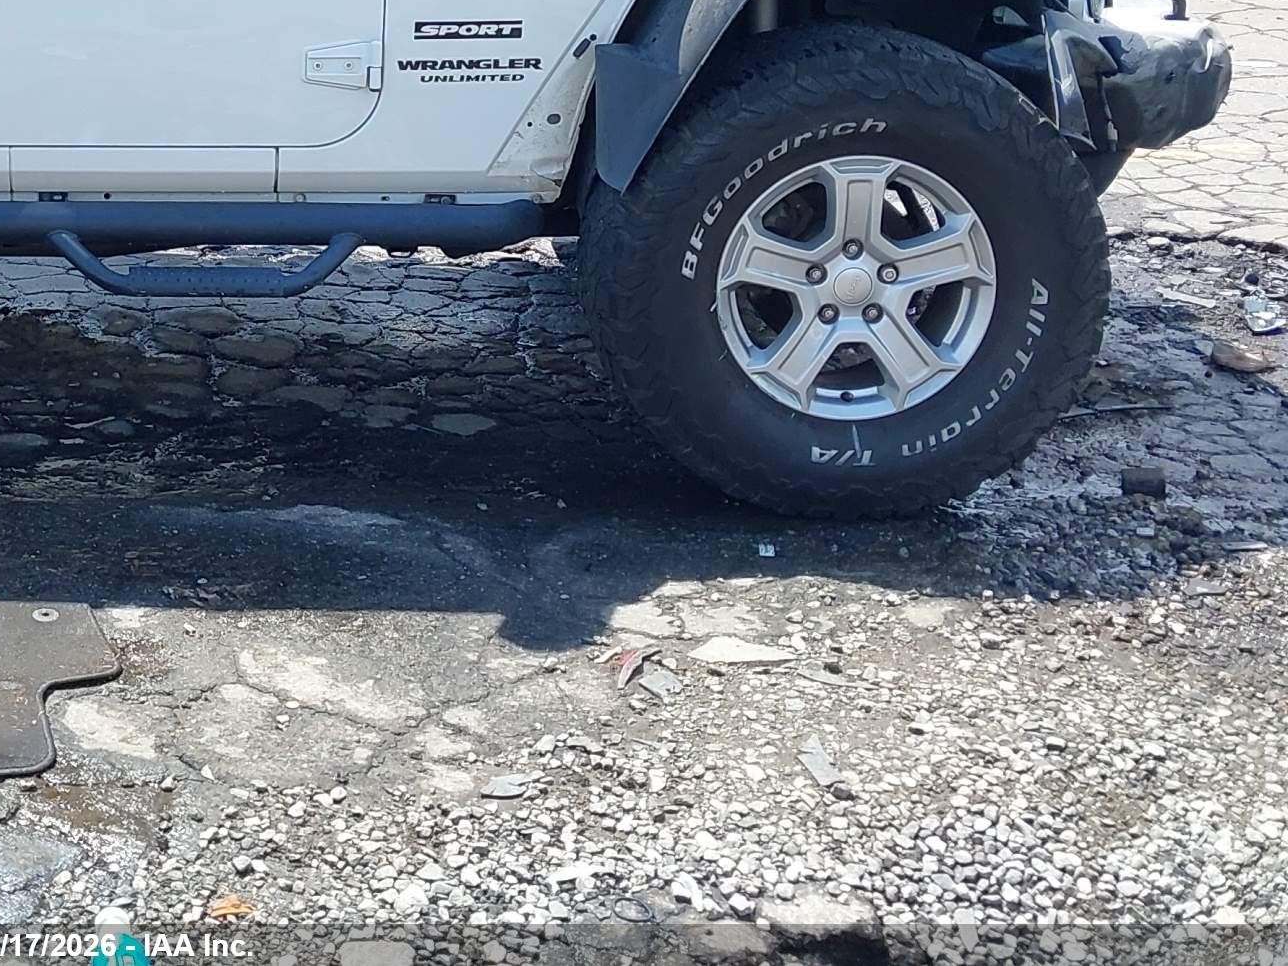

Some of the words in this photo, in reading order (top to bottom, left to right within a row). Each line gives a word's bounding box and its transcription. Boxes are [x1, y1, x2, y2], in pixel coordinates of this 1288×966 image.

[414, 22, 523, 38] SPORT
[397, 58, 543, 71] WRANGLER
[420, 74, 525, 83] UNLIMITED
[681, 118, 888, 280] BFGoodrich
[902, 277, 1049, 457] All-Terrain
[811, 446, 876, 466] T/A
